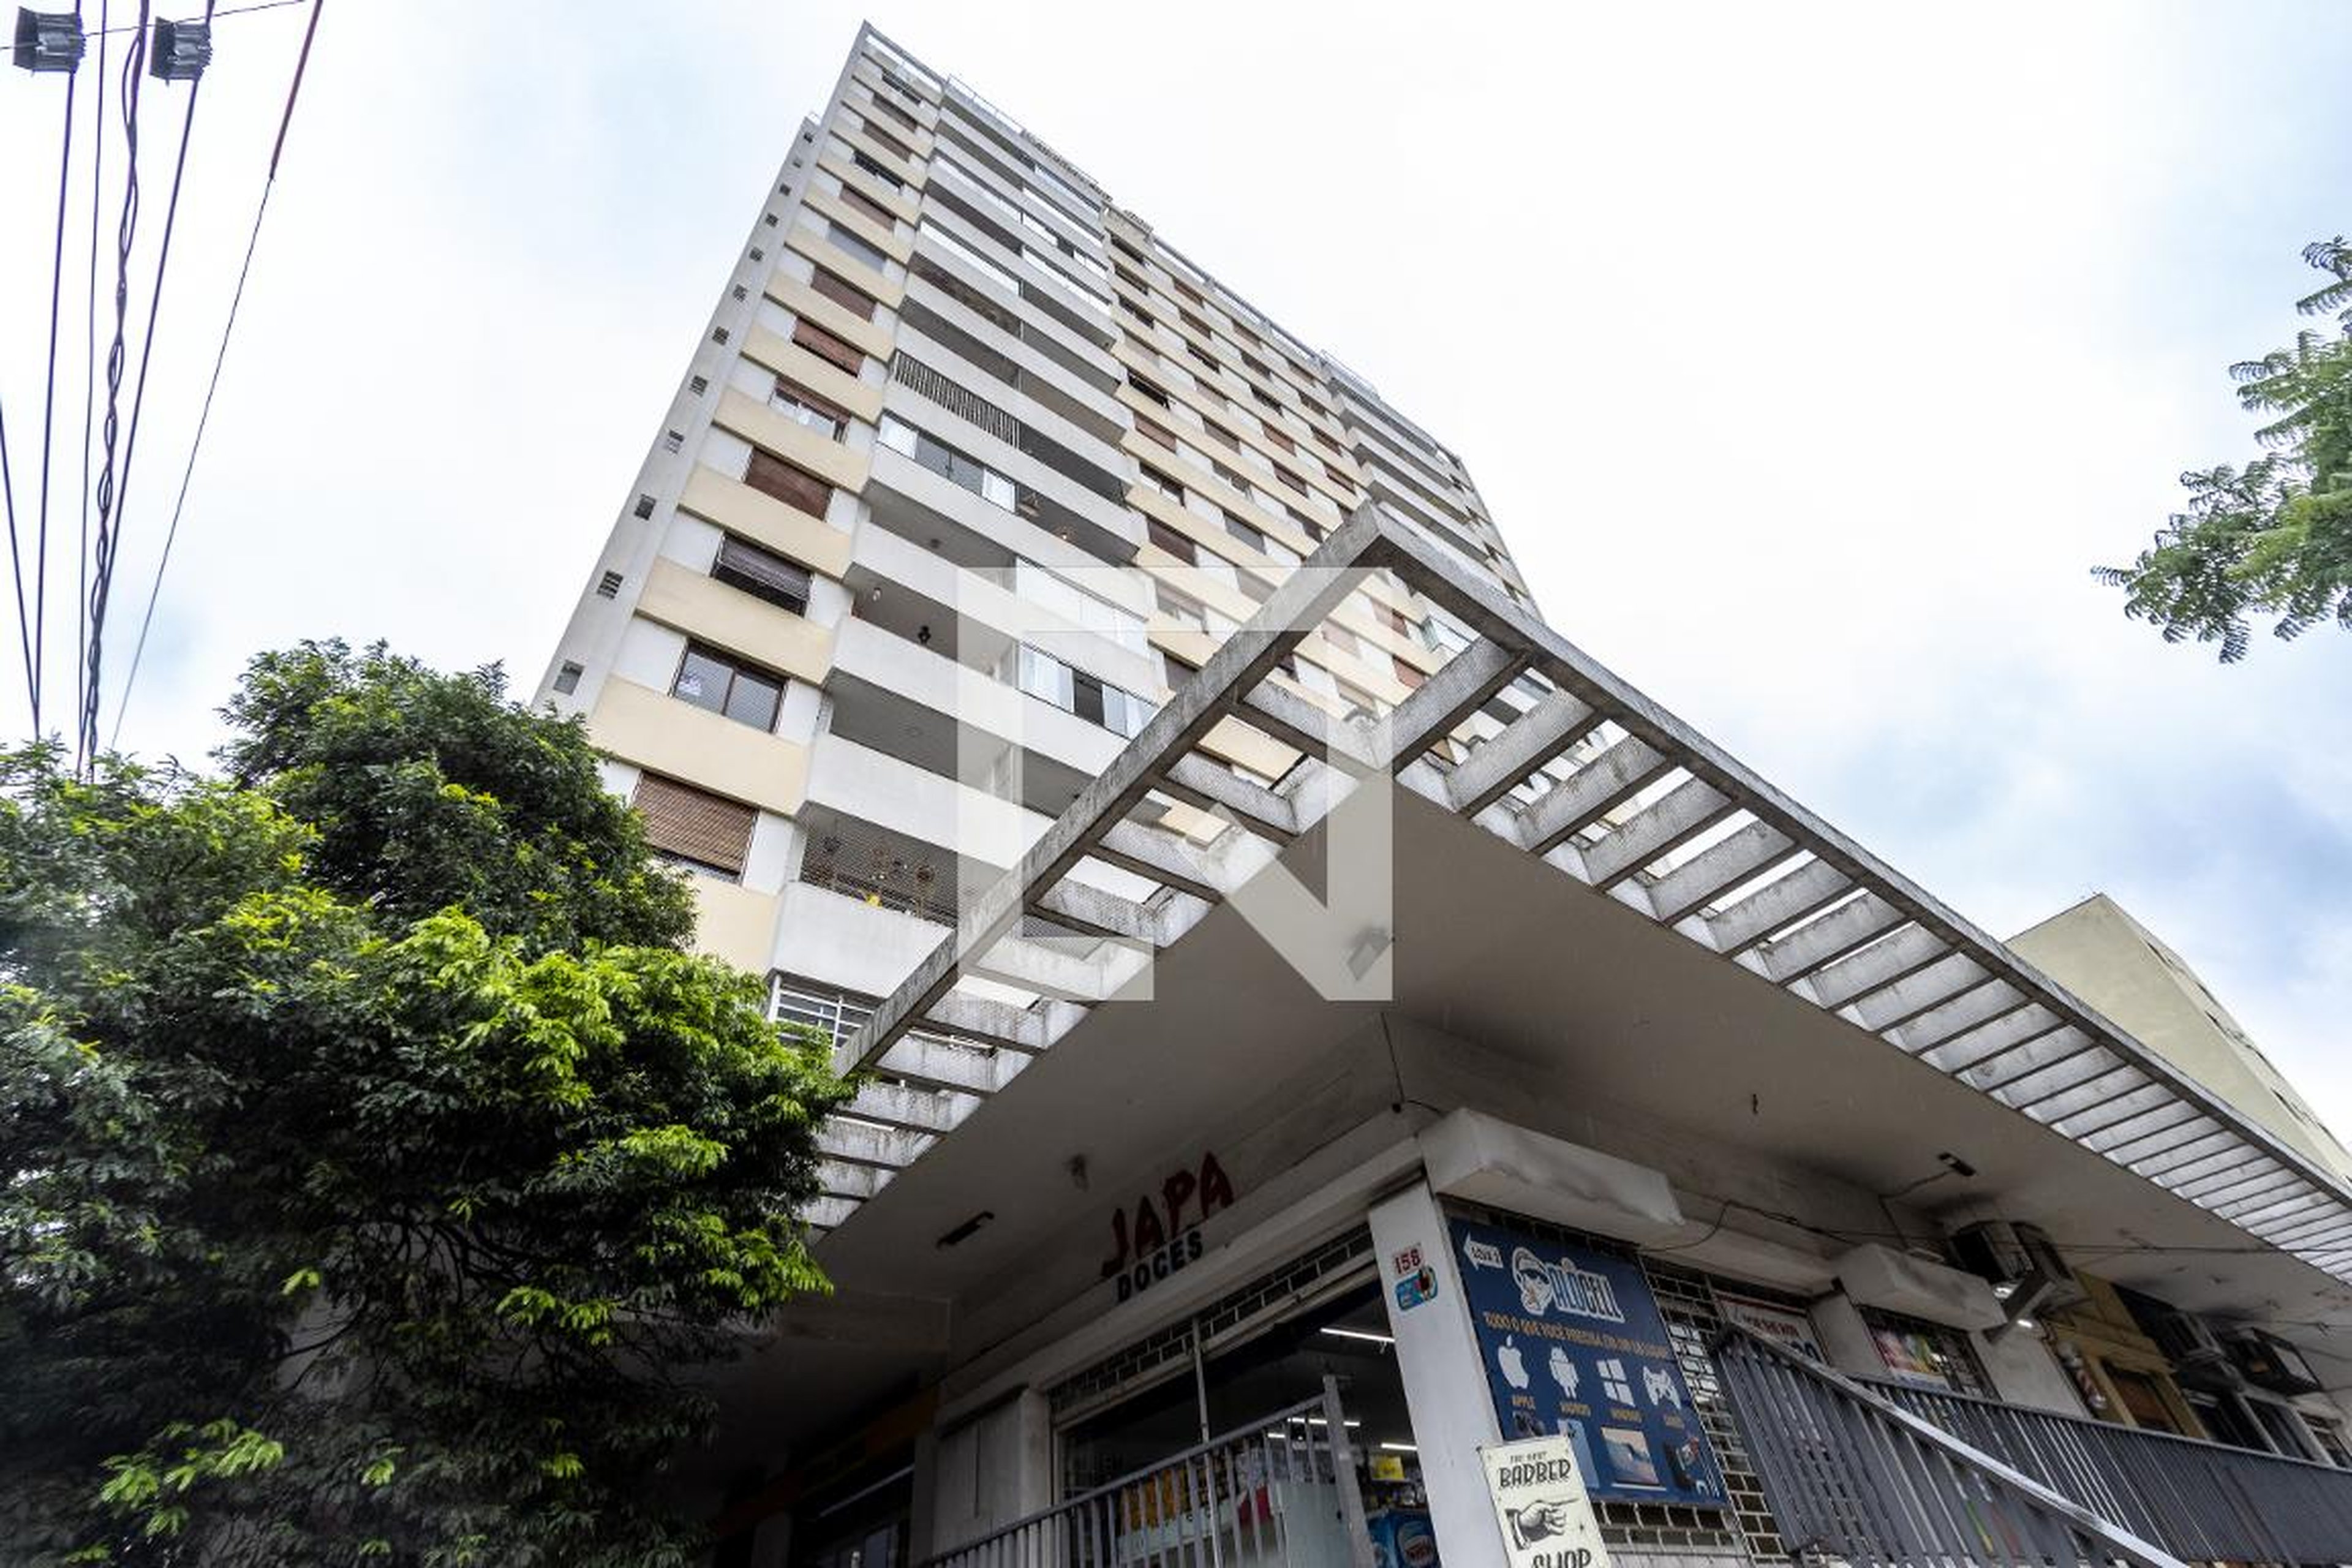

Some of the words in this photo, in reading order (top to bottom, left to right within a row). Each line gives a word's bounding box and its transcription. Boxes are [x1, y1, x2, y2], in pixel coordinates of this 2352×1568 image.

[1101, 1152, 1234, 1278] JAPA
[1117, 1231, 1202, 1303] DOCES
[1396, 1248, 1420, 1273] 158
[1498, 1458, 1572, 1489] BARBER
